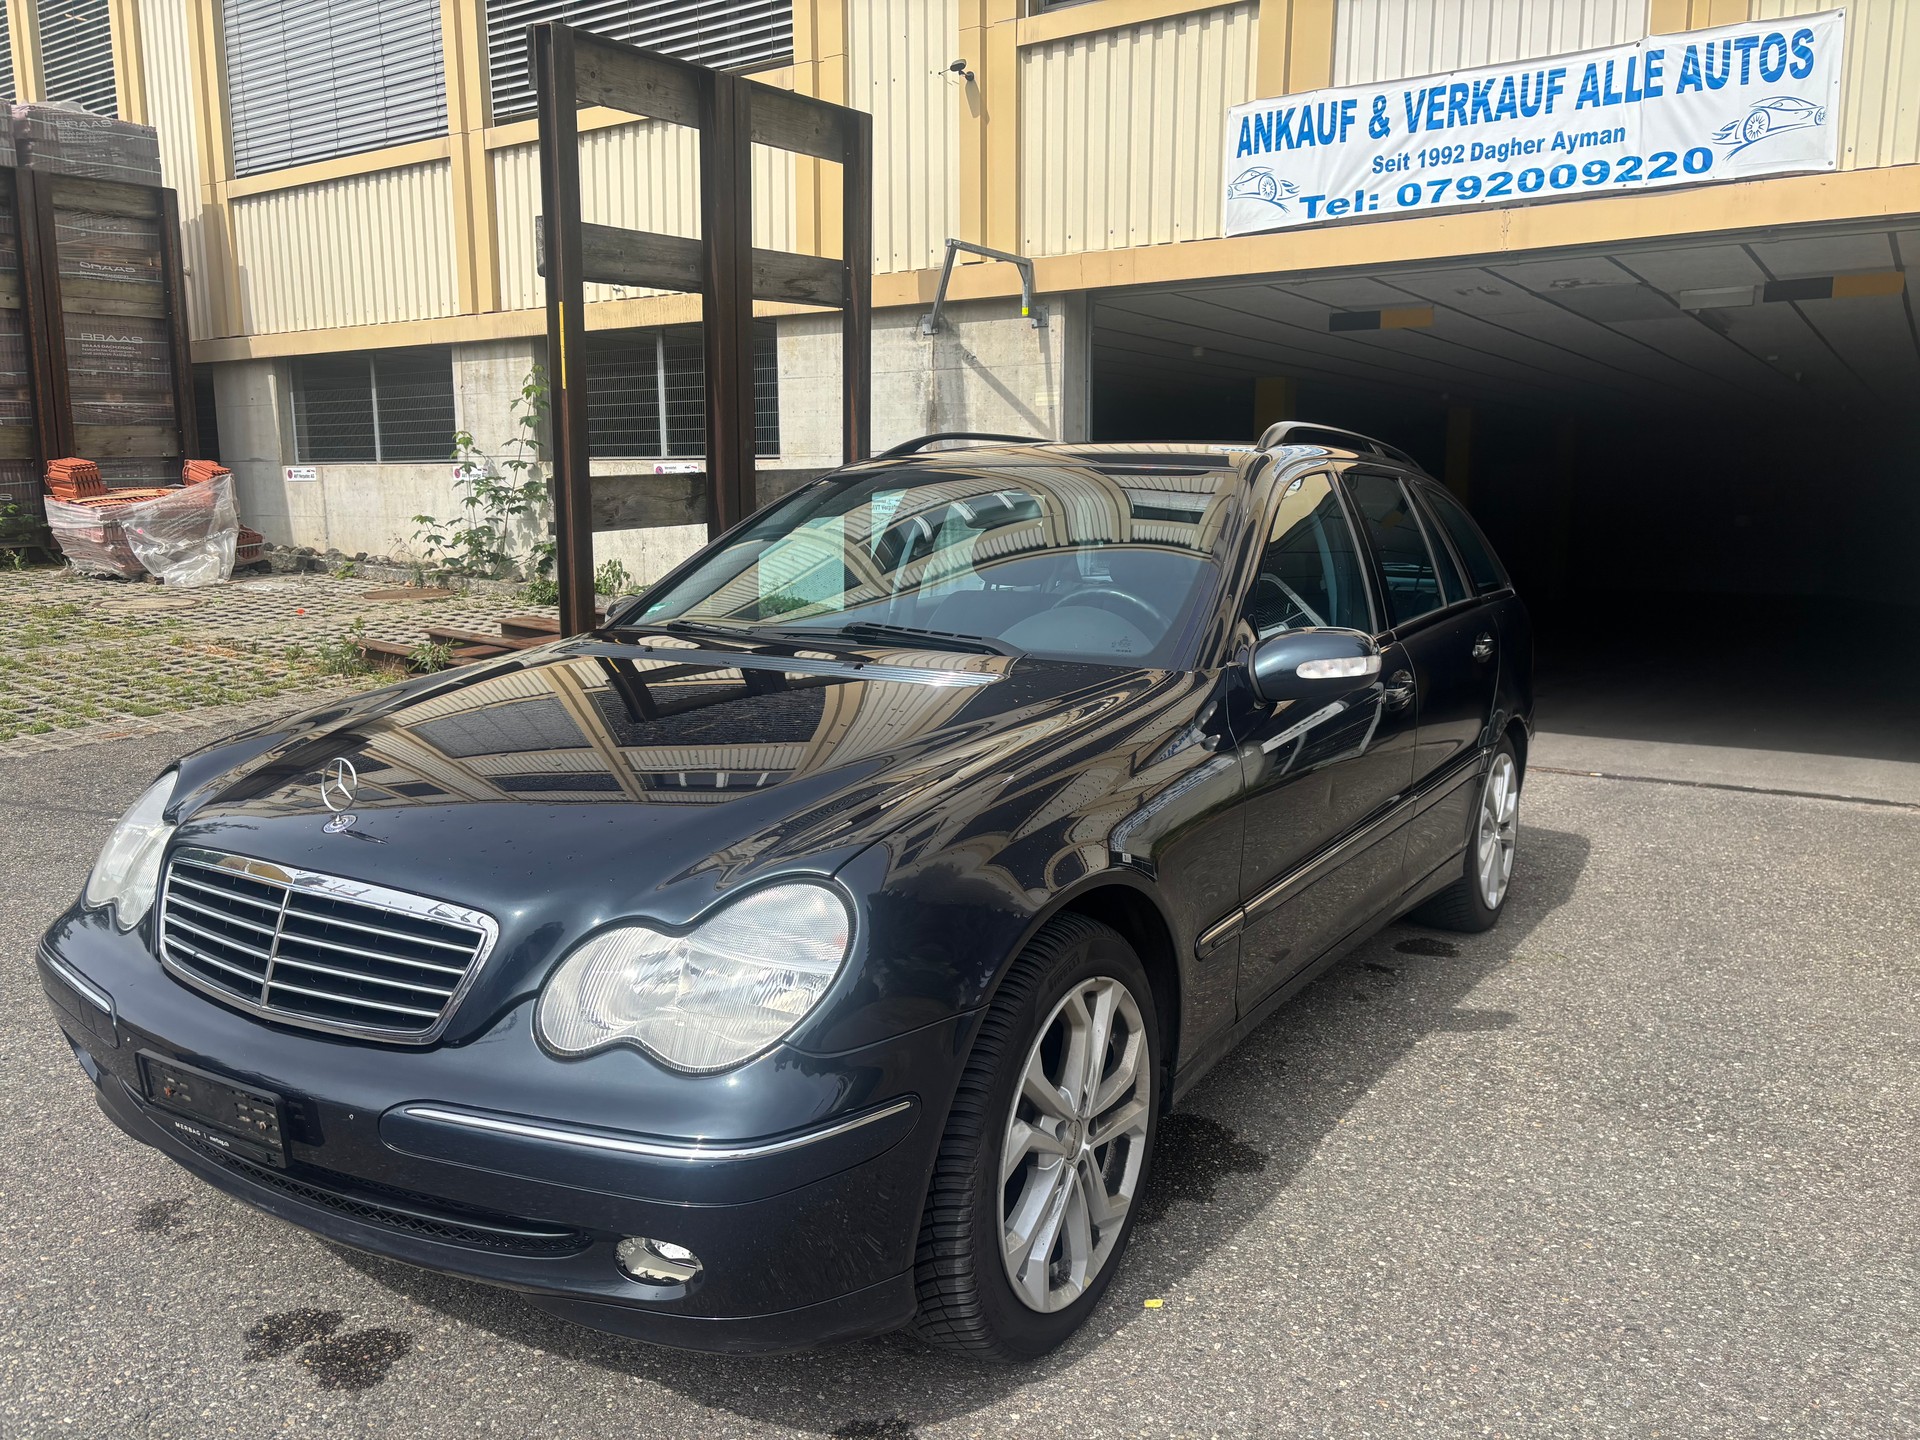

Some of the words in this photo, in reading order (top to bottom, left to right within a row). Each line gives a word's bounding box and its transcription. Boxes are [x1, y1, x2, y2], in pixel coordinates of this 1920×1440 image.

[1236, 99, 1358, 159] ANKAUF
[1368, 95, 1392, 139] &
[1404, 68, 1567, 134] VERKAUF
[1575, 49, 1666, 110] ALLE
[1676, 28, 1815, 94] AUTOS
[1372, 152, 1411, 174] Seit
[1417, 144, 1465, 169] 1992
[1470, 137, 1547, 164] Dagher
[1550, 127, 1627, 154] Ayman
[1299, 190, 1379, 219] Tel:
[1396, 146, 1714, 208] 0792009220
[81, 333, 143, 344] BRAAS
